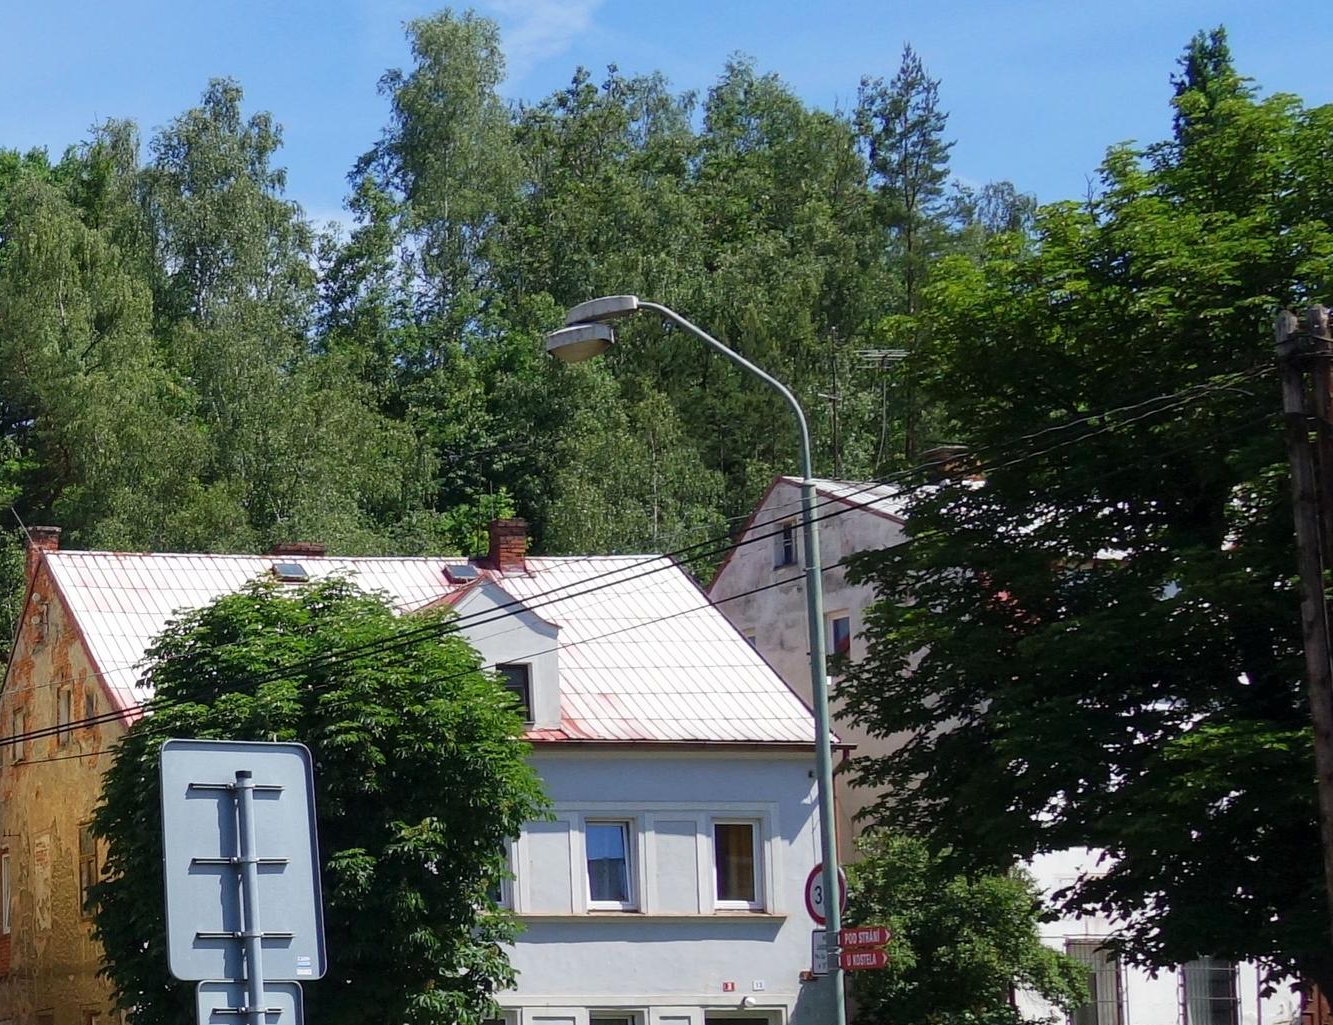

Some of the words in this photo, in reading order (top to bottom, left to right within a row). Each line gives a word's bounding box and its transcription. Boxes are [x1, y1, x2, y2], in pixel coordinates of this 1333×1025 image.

[844, 932, 858, 945] POD
[858, 928, 881, 944] STRÁNÍ
[853, 953, 877, 966] KOSTELA
